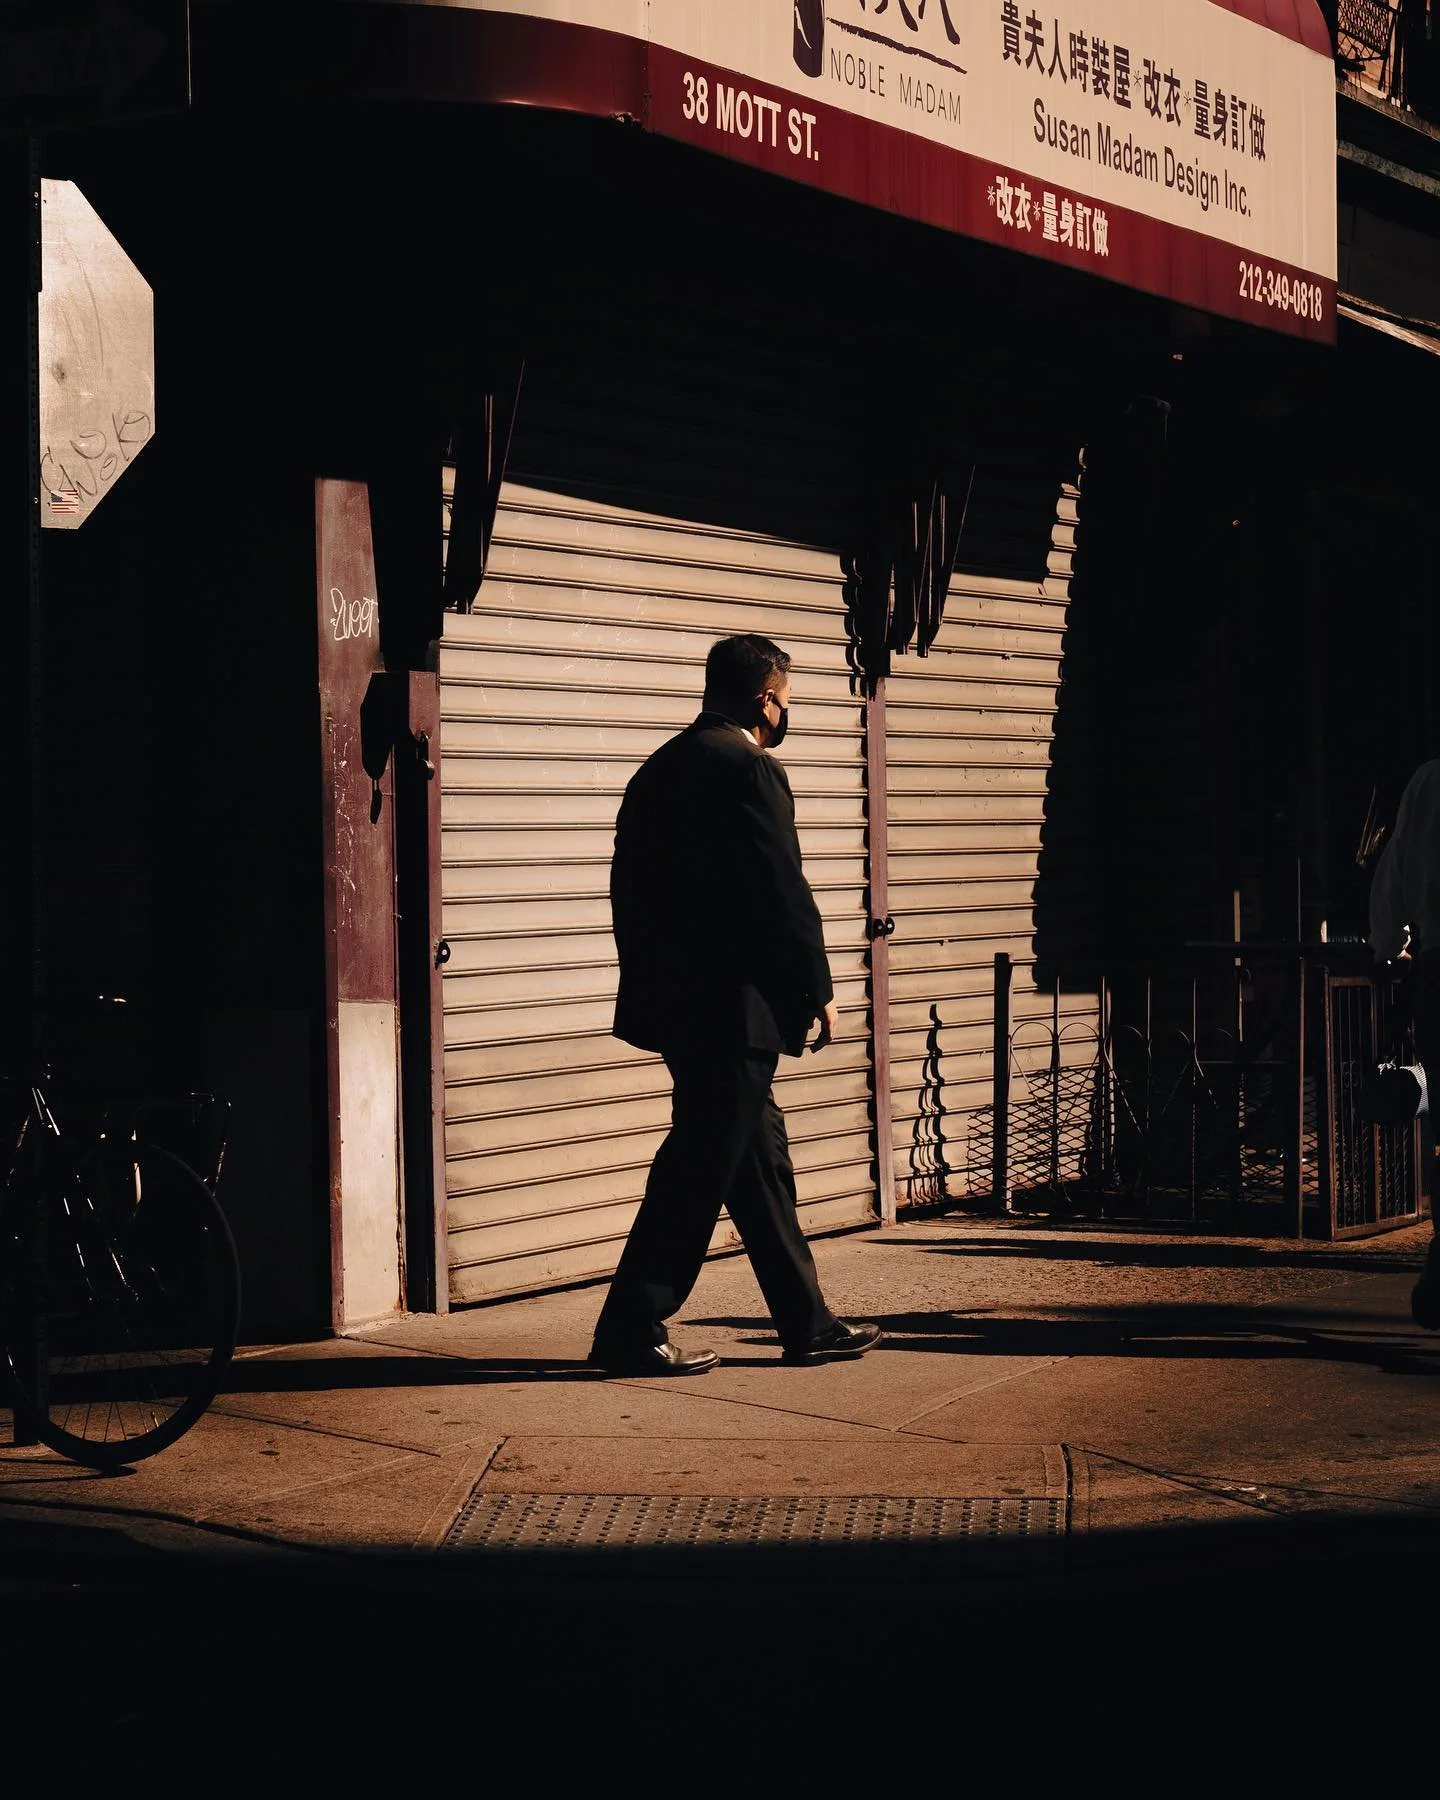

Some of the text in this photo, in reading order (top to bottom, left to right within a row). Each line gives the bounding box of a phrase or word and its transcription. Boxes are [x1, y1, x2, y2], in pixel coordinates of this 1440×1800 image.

[682, 71, 819, 161] 38 MOTT ST.
[830, 47, 961, 125] NOBLE MADAM
[1033, 98, 1252, 217] Susan Madam Design Inc.
[1239, 260, 1323, 322] 212-349-0818
